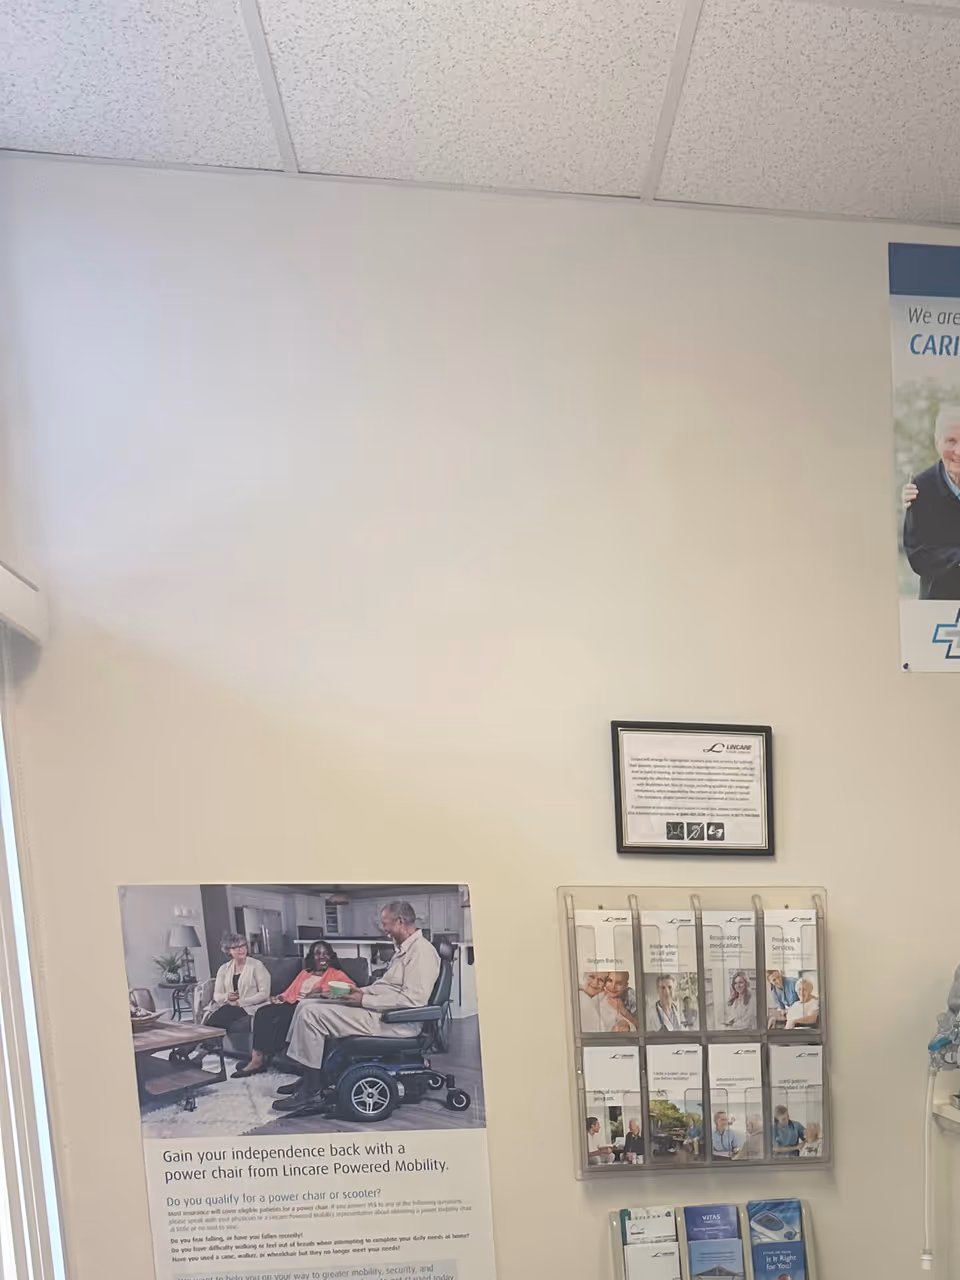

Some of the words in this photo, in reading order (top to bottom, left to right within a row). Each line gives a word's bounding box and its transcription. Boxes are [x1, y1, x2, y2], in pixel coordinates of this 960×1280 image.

[908, 307, 932, 324] We
[163, 1150, 193, 1163] Gain
[197, 1150, 227, 1164] your
[231, 1145, 325, 1162] independence
[329, 1142, 361, 1157] back
[365, 1141, 393, 1155] with
[397, 1144, 405, 1154] a
[165, 1169, 207, 1184] power
[211, 1165, 243, 1179] chair
[248, 1164, 278, 1178] from
[283, 1163, 329, 1177] Lincare
[333, 1159, 390, 1174] Powered
[395, 1158, 449, 1174] Mobility.
[166, 1196, 180, 1206] Do
[184, 1197, 202, 1207] you
[205, 1193, 239, 1207] qualify
[243, 1193, 255, 1203] for
[268, 1193, 298, 1204] power
[302, 1190, 326, 1201] chair
[329, 1191, 339, 1199] or
[342, 1189, 380, 1199] scooter?
[780, 1254, 797, 1262] Right
[274, 1272, 291, 1280] your
[293, 1272, 309, 1280] way
[322, 1270, 349, 1279] greater
[351, 1267, 384, 1277] mobility,
[419, 1264, 433, 1272] and
